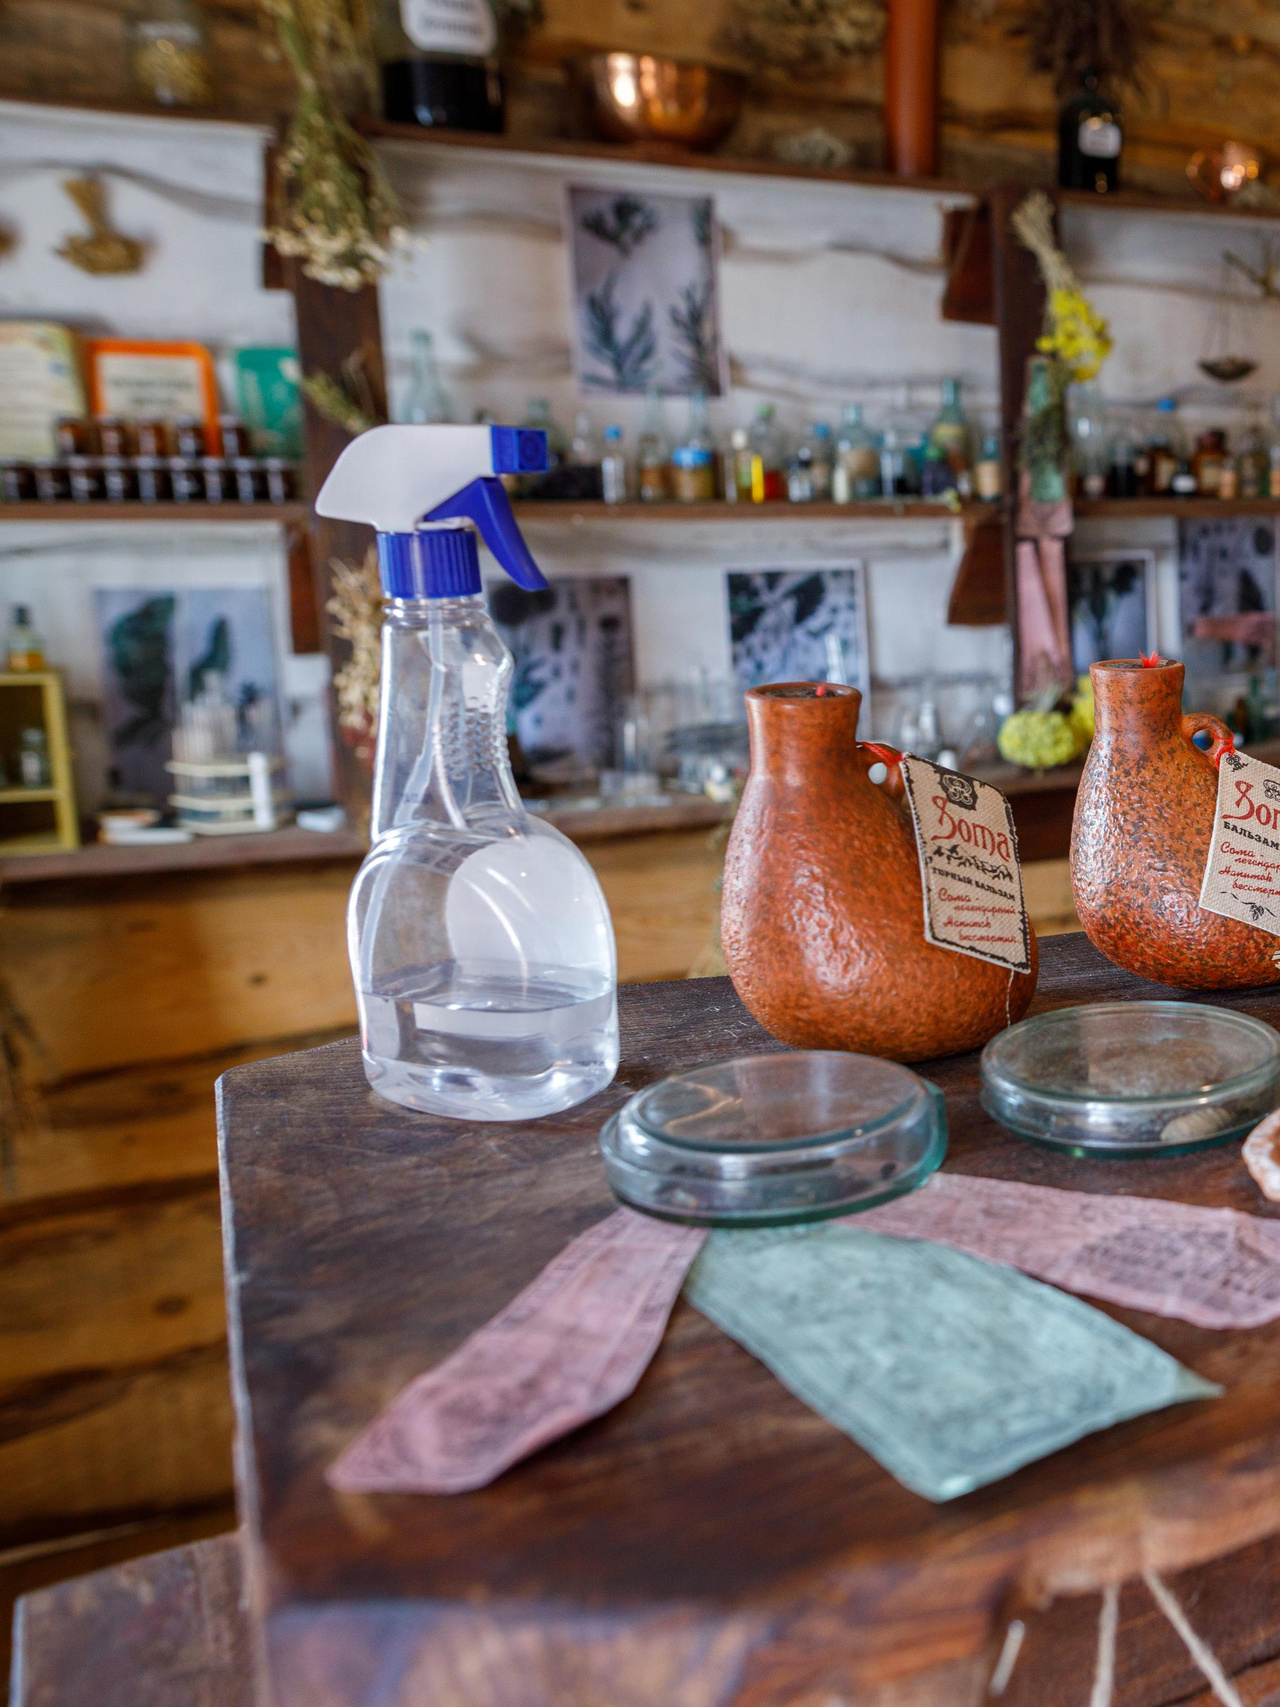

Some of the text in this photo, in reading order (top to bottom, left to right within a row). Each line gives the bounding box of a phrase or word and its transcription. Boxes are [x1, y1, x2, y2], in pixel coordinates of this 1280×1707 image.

[1223, 821, 1280, 850] БАЛЬЗАМ
[1218, 866, 1273, 882] Напиток
[932, 866, 1016, 901] ГОРНЫЙ БАЛЬЗАМ
[953, 904, 1016, 916] легендарный
[943, 914, 991, 928] Напиток
